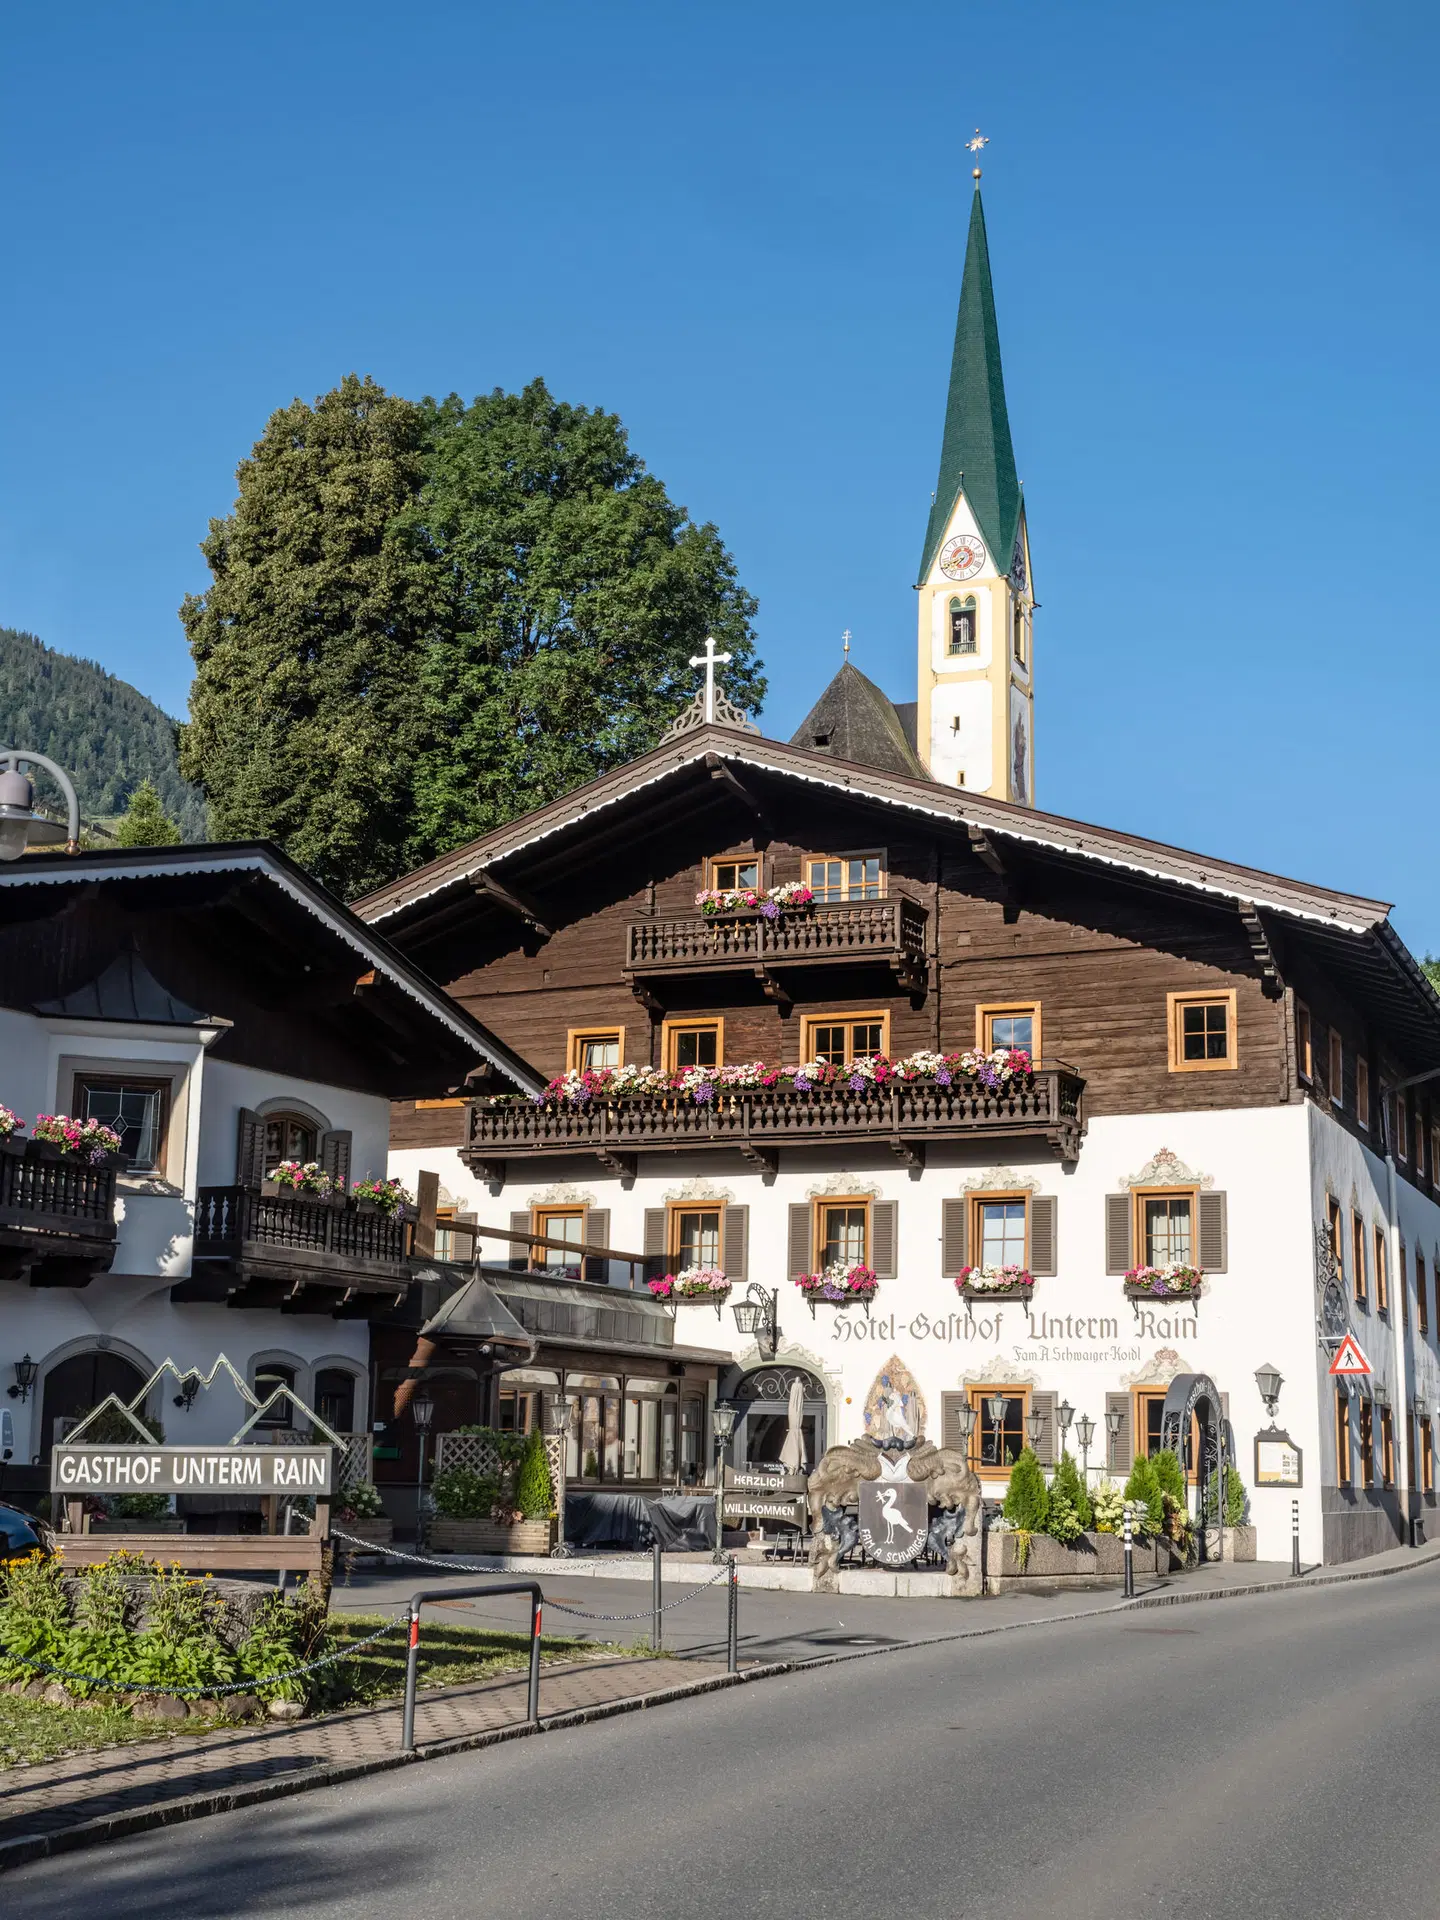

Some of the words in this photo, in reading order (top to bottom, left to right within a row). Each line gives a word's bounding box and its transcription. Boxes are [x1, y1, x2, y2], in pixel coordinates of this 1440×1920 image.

[1027, 1311, 1118, 1339] Unterm
[1134, 1311, 1198, 1339] Rain
[60, 1456, 161, 1484] GASTHOF
[172, 1457, 262, 1484] UNTERM
[273, 1458, 326, 1485] RAIN
[733, 1475, 785, 1489] HERZLICH
[724, 1503, 796, 1517] WILLKOMMEN
[886, 1528, 927, 1562] SCHWAIGER
